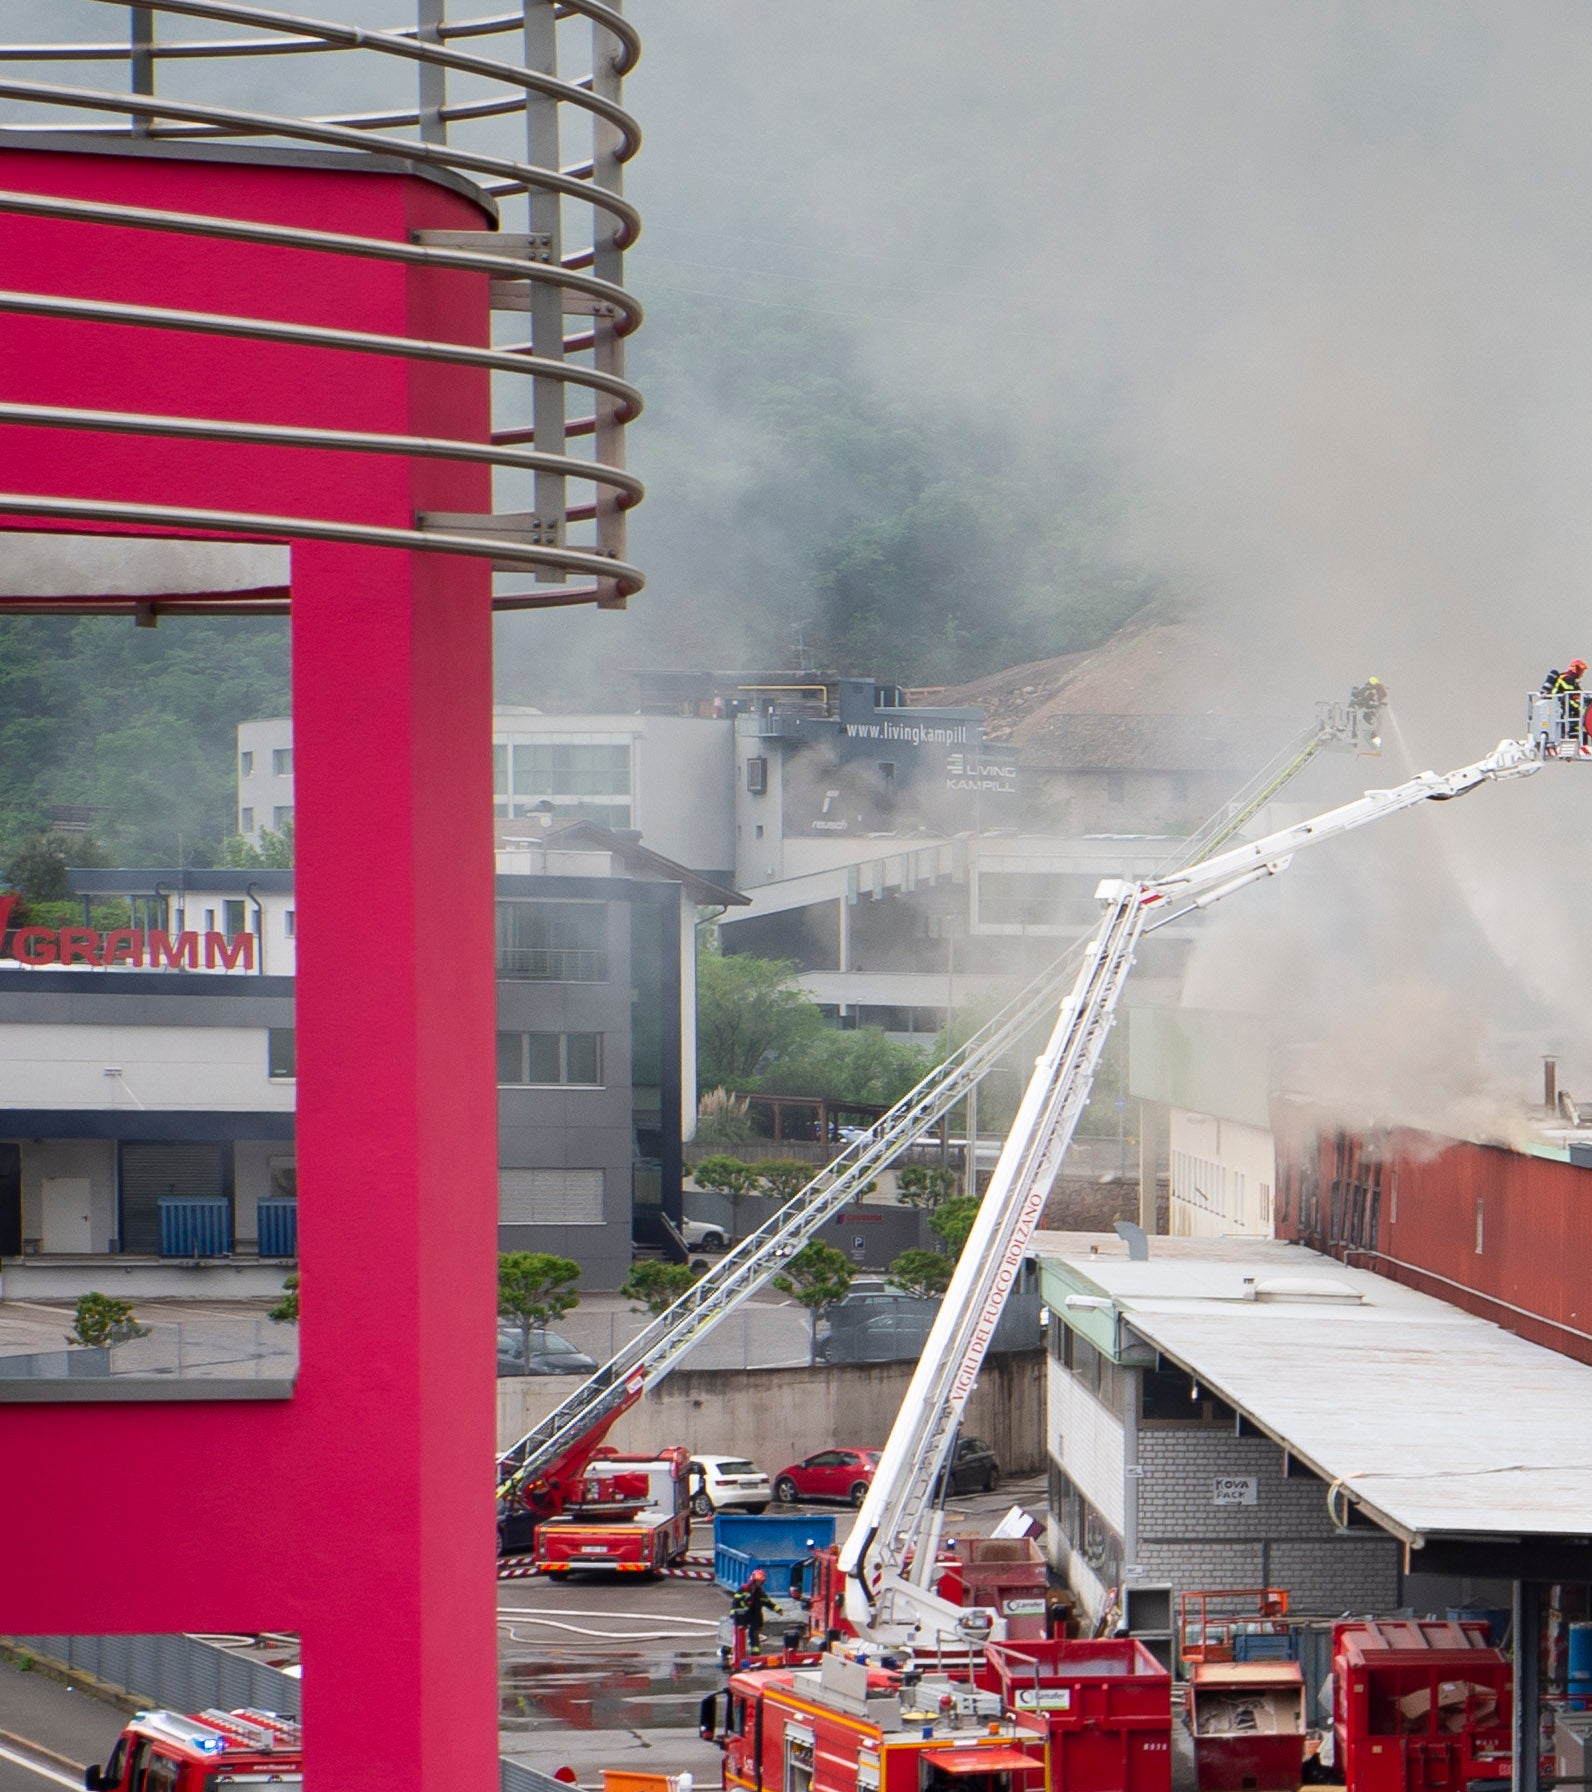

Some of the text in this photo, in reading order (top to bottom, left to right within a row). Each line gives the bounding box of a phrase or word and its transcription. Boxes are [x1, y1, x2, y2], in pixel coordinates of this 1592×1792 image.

[846, 721, 966, 746] www.livingkampill
[966, 764, 1016, 778] LIVING
[946, 778, 1015, 793] KAMPILL
[811, 818, 848, 830] reusch
[12, 926, 254, 970] GRAMM
[952, 1193, 1042, 1401] VIGILI DEL FUOCO BOLZANO
